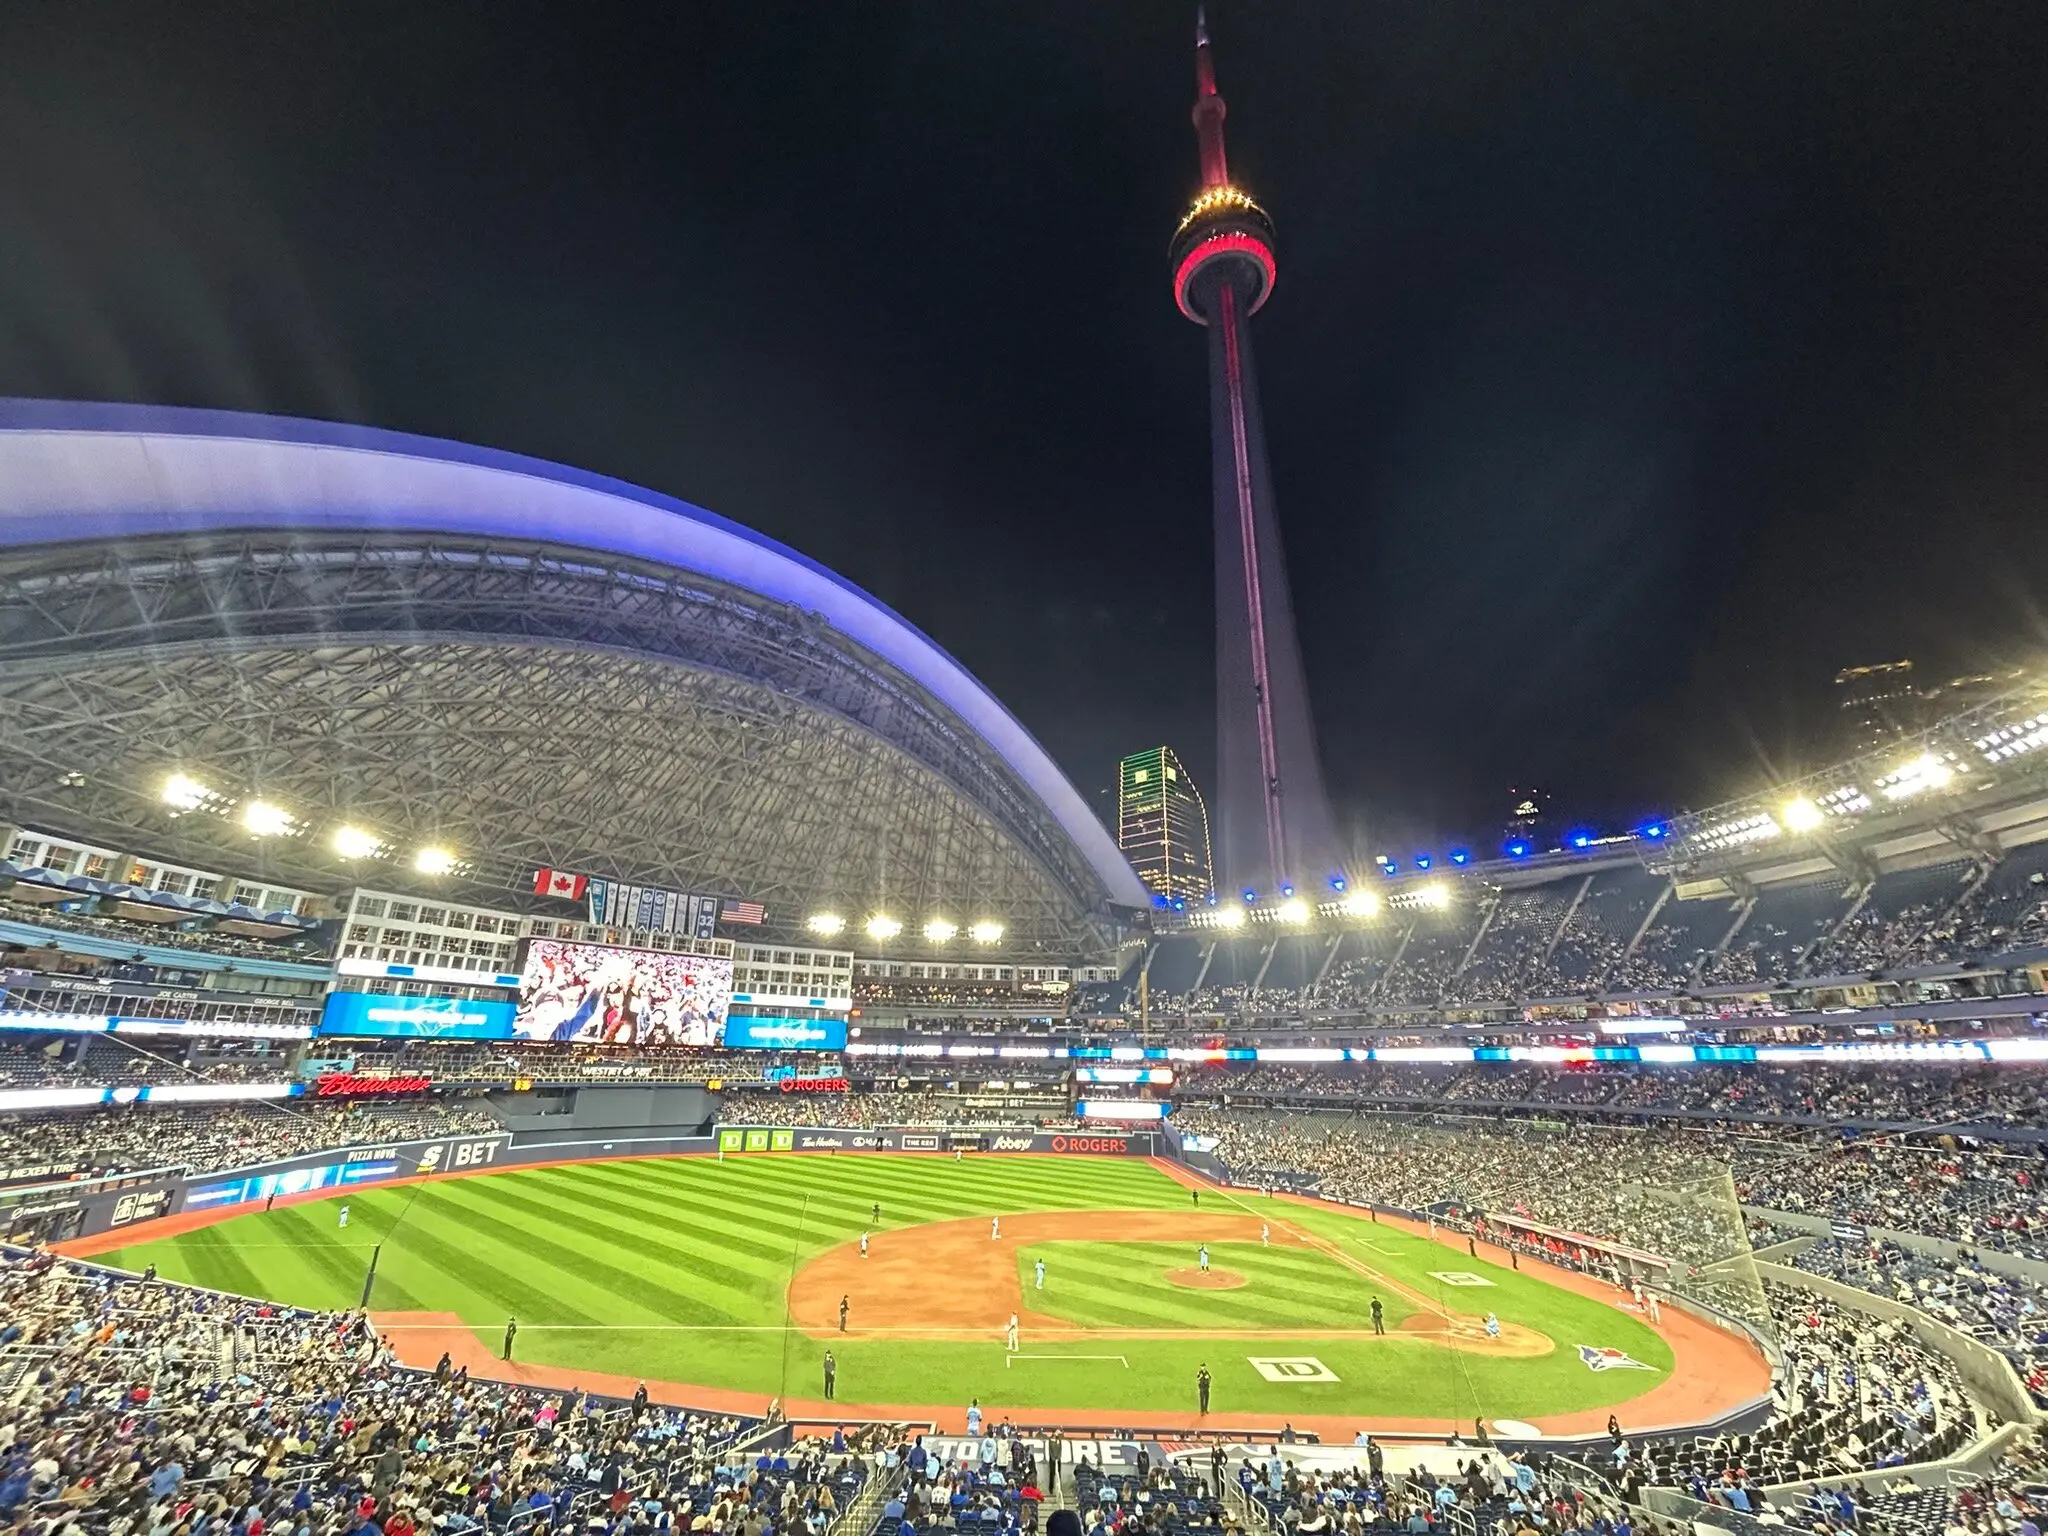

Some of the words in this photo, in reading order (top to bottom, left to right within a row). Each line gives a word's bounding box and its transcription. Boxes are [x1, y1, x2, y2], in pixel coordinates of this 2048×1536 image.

[699, 916, 713, 926] 32
[582, 1066, 623, 1076] WESTJET
[317, 1073, 431, 1096] Budweiser
[796, 1079, 848, 1091] ROGERS
[1009, 1099, 1024, 1107] BET
[724, 1136, 737, 1147] TD
[750, 1135, 762, 1146] TD
[993, 1136, 1032, 1151] Sobeys
[1070, 1138, 1127, 1152] ROGERS
[347, 1151, 373, 1162] PIZZA
[374, 1148, 397, 1160] NOVA
[455, 1141, 500, 1166] BET
[10, 1165, 52, 1179] NEXEN
[53, 1163, 78, 1173] TIRE
[1259, 1362, 1322, 1376] TD
[939, 1441, 979, 1460] TO
